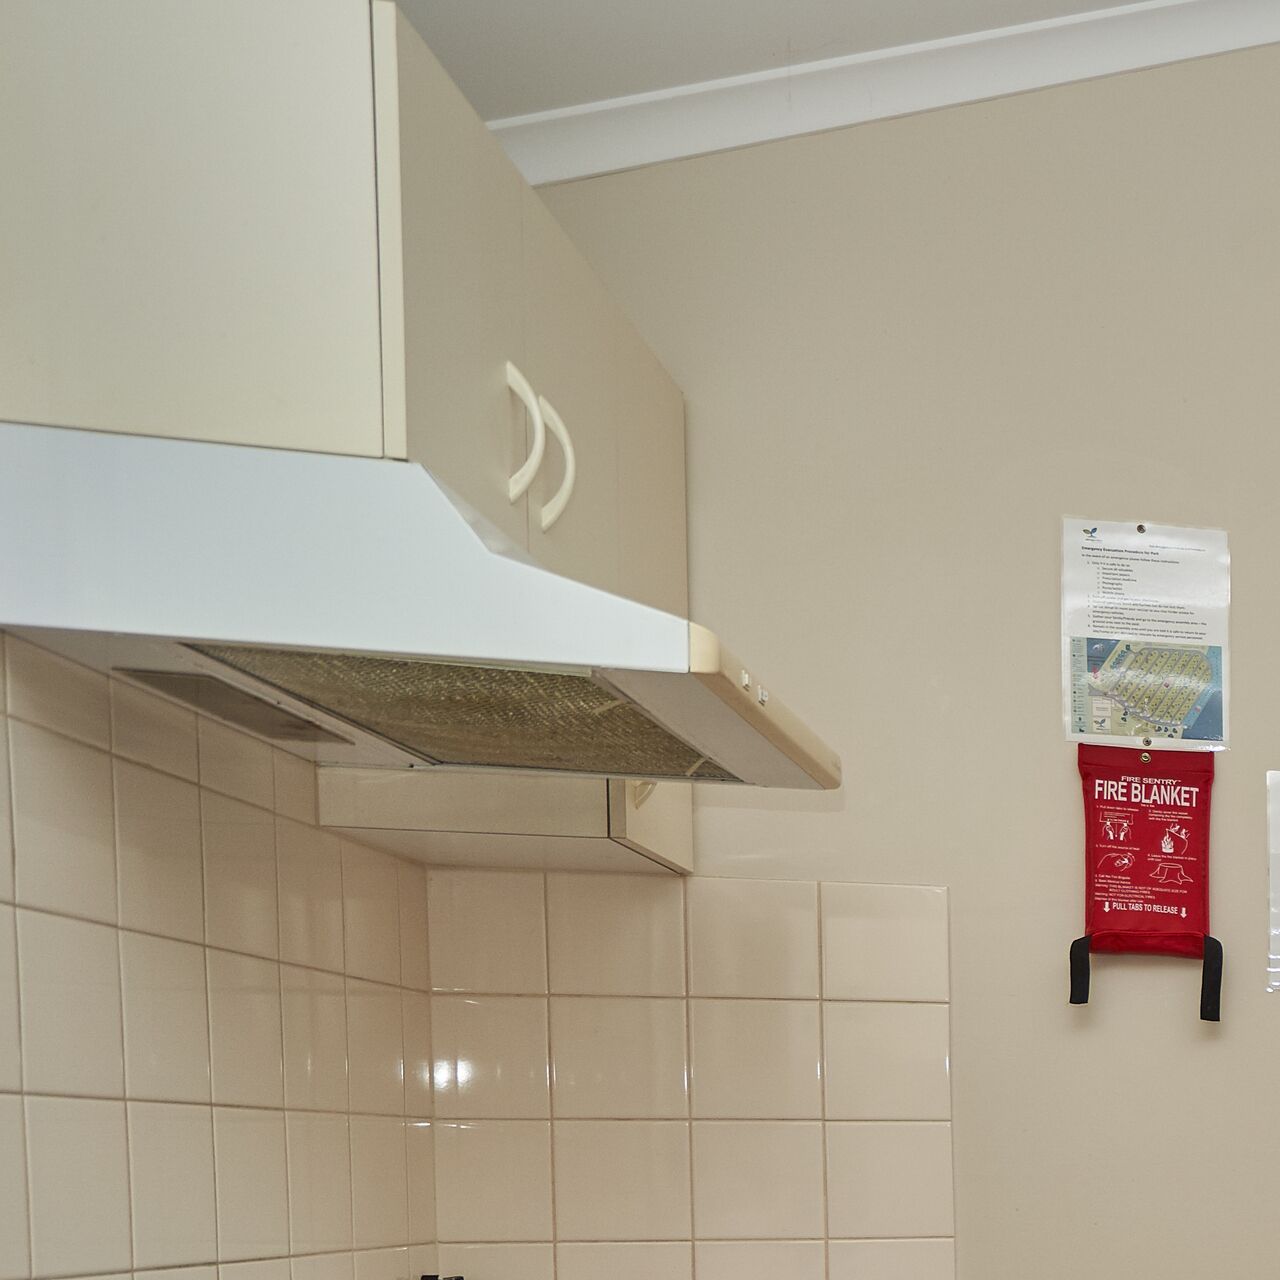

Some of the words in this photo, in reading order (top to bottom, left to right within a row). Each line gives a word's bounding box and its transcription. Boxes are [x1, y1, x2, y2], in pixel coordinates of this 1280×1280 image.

[1094, 779, 1127, 802] FIRE
[1132, 784, 1199, 807] BLANKET
[1112, 902, 1127, 910] PULL
[1128, 903, 1143, 911] TABS
[1152, 904, 1178, 914] RELEASE
